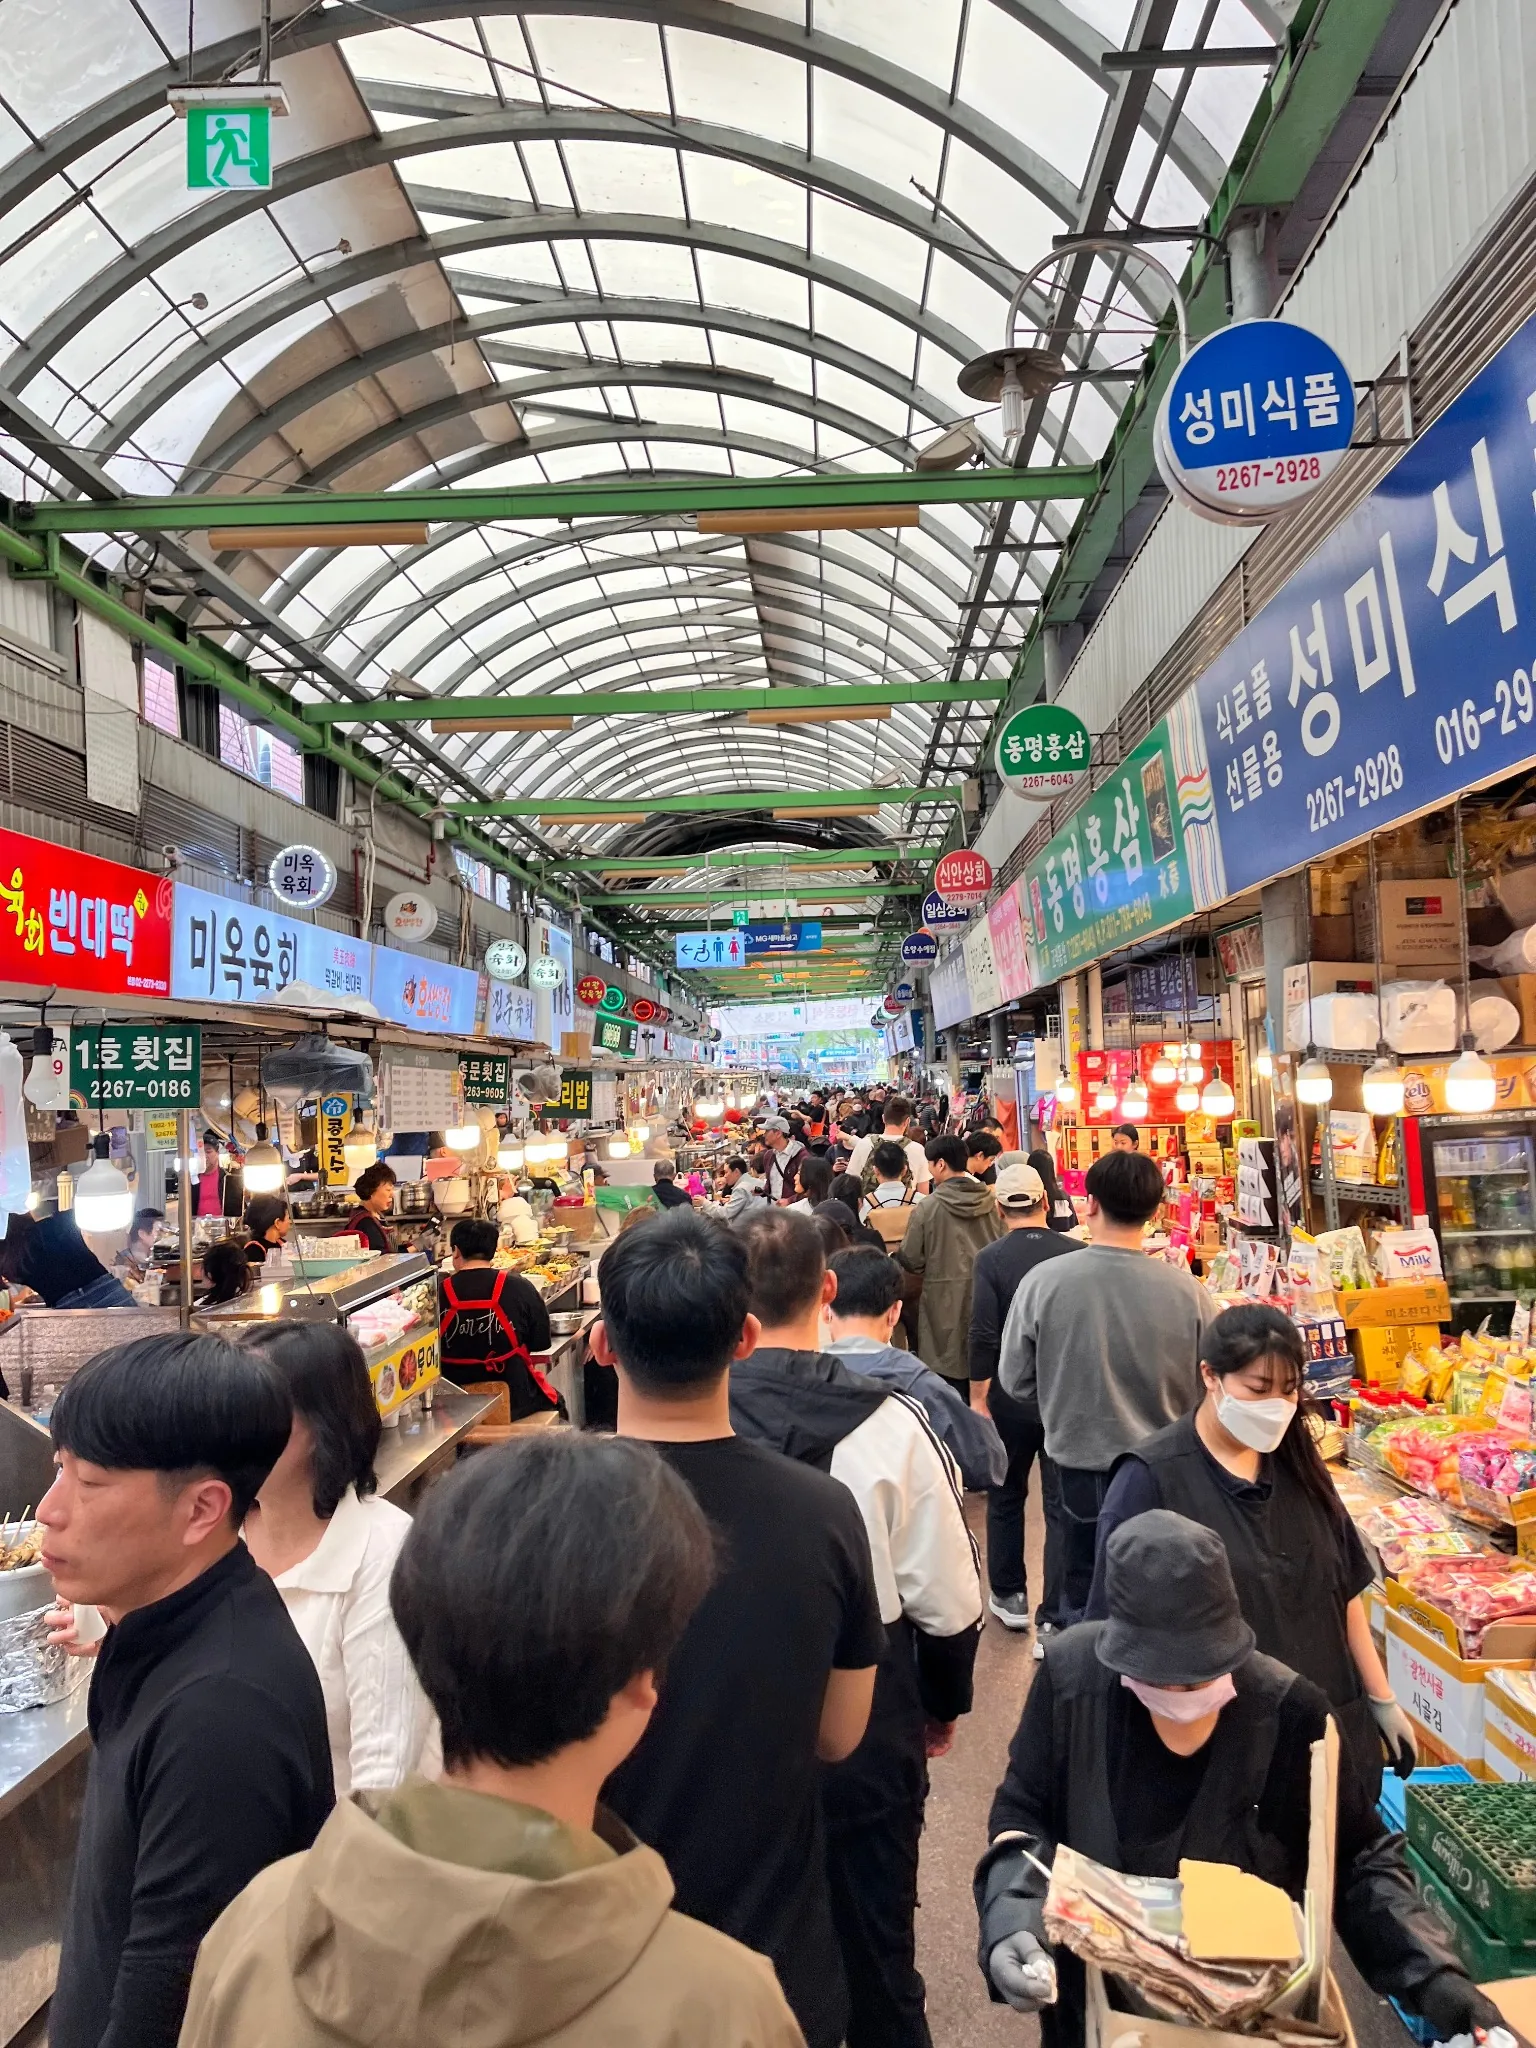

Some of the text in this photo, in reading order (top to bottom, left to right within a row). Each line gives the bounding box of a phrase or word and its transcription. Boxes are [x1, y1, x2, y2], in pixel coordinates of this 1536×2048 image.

[1178, 372, 1341, 445] 성미식품
[1217, 457, 1321, 491] 2267-2928
[1287, 390, 1536, 757] 성미식
[1216, 658, 1273, 745] 식료품
[1004, 730, 1085, 763] 동명홍삼
[1022, 773, 1074, 788] 2267-6043
[1226, 730, 1283, 812] 선물용
[1306, 744, 1404, 832] 2267-2928
[284, 853, 315, 873] 미옥
[1046, 778, 1143, 933] 동명홍삼
[281, 876, 312, 895] 육회
[939, 860, 986, 888] 신안상회
[49, 888, 135, 967] 빈대떡
[190, 909, 299, 999] 미옥육회
[489, 953, 518, 967] 육회
[533, 969, 559, 980] 육회
[492, 988, 533, 1029] 진주육회
[75, 1036, 193, 1071] 1호 횟집
[90, 1079, 191, 1099] 2267-0186
[327, 1098, 346, 1115] 冷
[1400, 1255, 1431, 1266] Milk
[1410, 1658, 1444, 1700] 광천시골
[1412, 1691, 1443, 1733] 시골김
